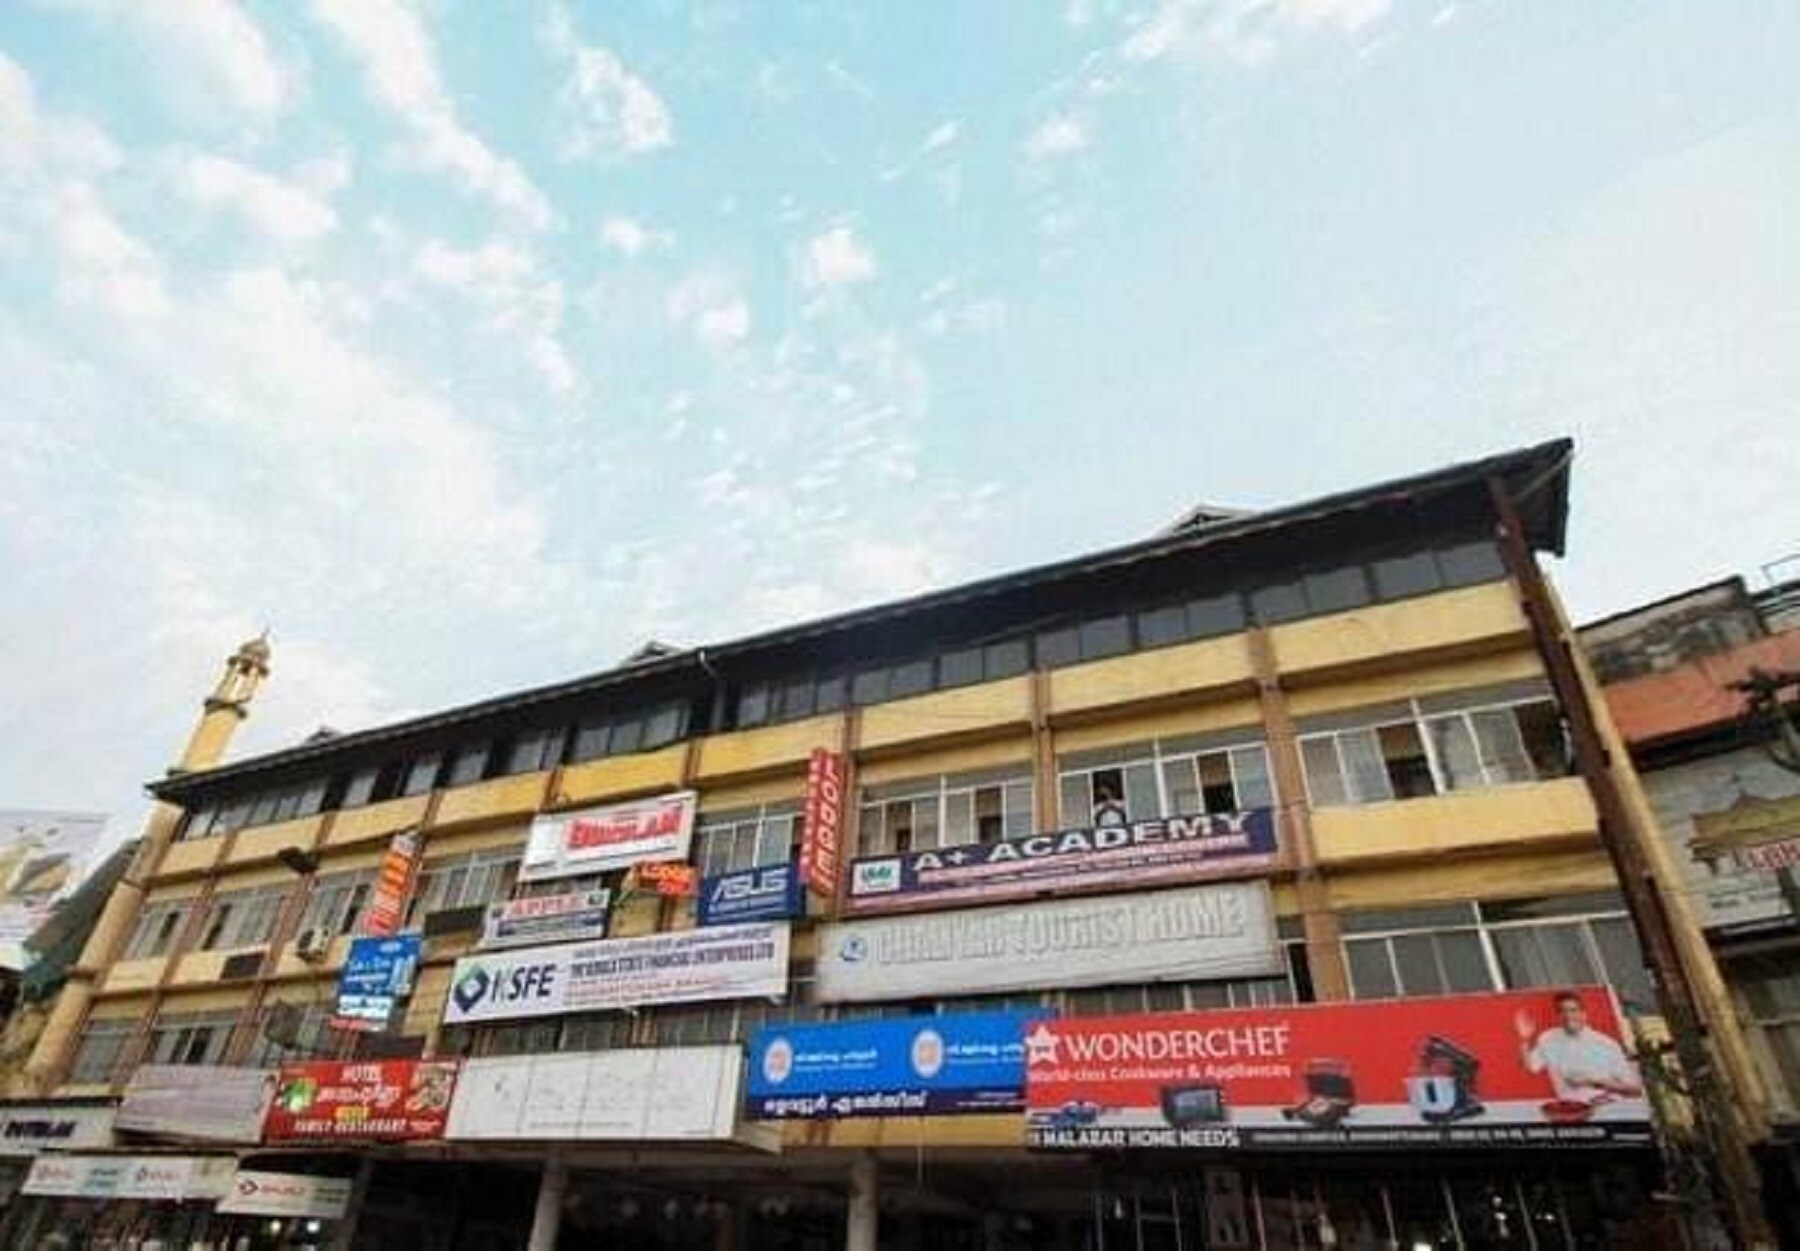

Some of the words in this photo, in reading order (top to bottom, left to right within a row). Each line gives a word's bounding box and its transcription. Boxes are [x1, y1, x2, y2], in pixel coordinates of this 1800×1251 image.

[913, 852, 967, 872] A+
[988, 811, 1252, 862] ACADEMY
[708, 866, 789, 903] ASUS
[1064, 1025, 1290, 1061] WONDERCHEF
[1043, 1128, 1125, 1148] MALABAR
[1128, 1127, 1177, 1147] HOME
[1180, 1125, 1240, 1147] NEEDS
